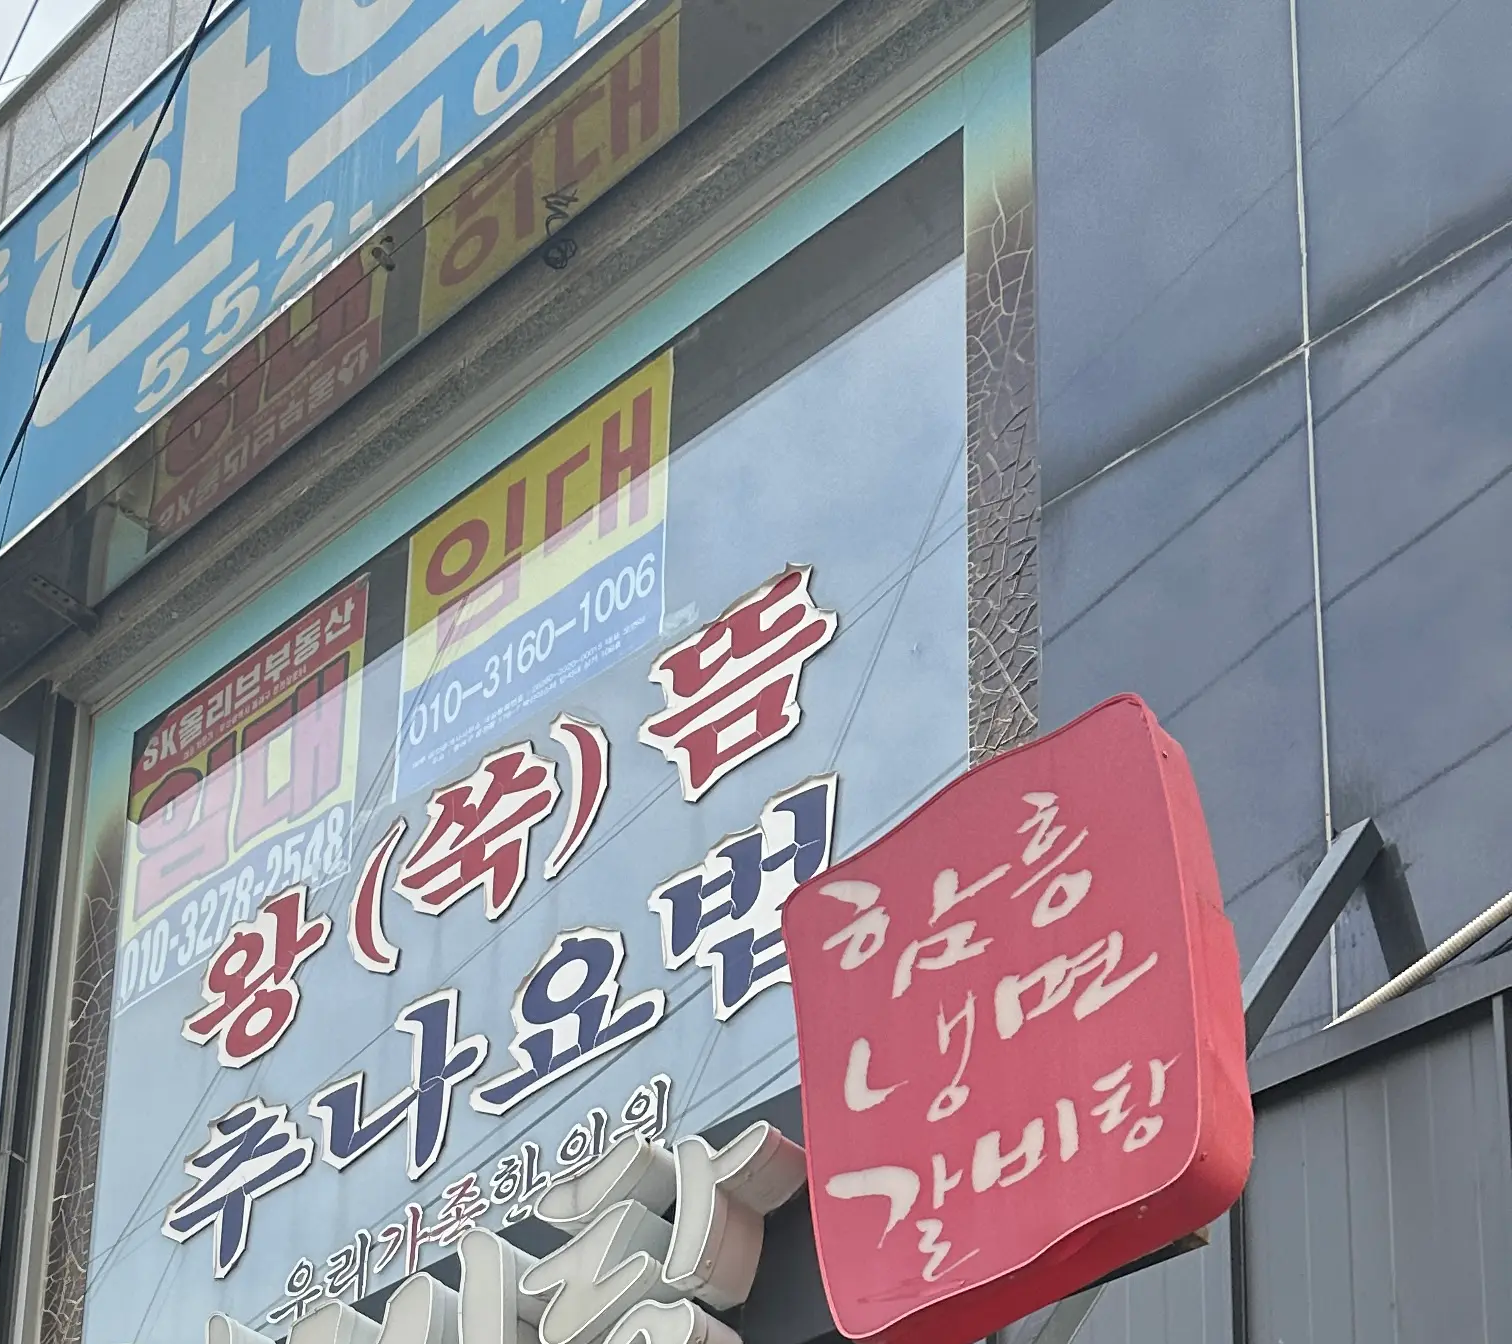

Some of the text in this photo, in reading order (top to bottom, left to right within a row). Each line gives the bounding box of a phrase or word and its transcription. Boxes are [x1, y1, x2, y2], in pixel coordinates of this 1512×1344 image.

[423, 387, 652, 652] 임대
[142, 597, 356, 772] SK올리브부동산
[408, 551, 656, 746] 010-3160-1006
[133, 651, 351, 922] 임대
[119, 805, 347, 998] 010-3278-2548
[819, 790, 1092, 998] 함흥
[164, 777, 834, 1274] 추나요법
[843, 929, 1159, 1122] 냉면
[825, 1052, 1181, 1283] 갈비탕
